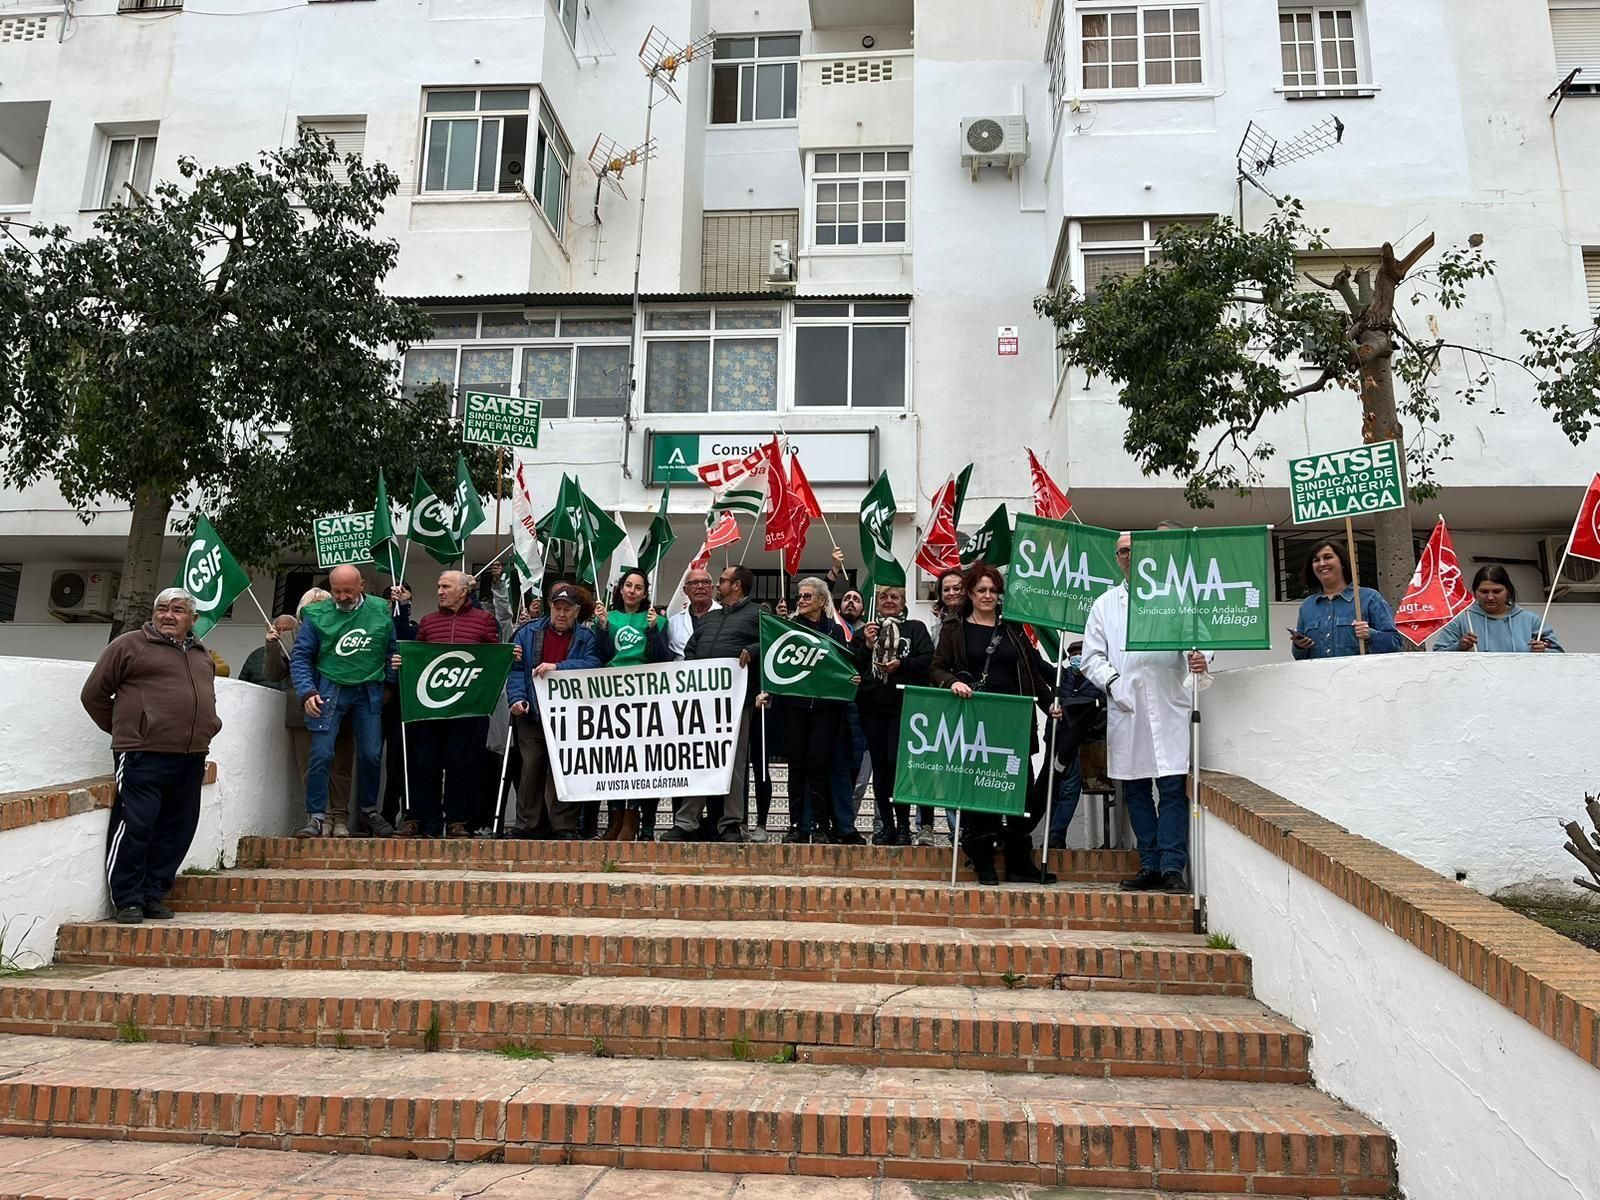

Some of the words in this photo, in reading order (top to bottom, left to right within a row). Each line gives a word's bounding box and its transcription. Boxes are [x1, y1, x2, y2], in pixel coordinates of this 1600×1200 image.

[469, 394, 539, 418] SATSE
[468, 411, 520, 425] SINDICATO
[523, 418, 537, 427] DE
[468, 419, 536, 434] ENFERMERIA
[466, 427, 534, 447] MALAGA
[1294, 444, 1393, 481] SATSE
[1295, 472, 1370, 493] SINDICATO
[1374, 467, 1394, 480] DE
[1296, 478, 1395, 503] ENFERMERIA
[1297, 489, 1397, 520] MALAGA
[319, 532, 365, 545] SINDICATO
[320, 539, 371, 552] ENFERMER
[321, 547, 373, 565] MALAG
[1016, 539, 1091, 591] SMA
[188, 544, 222, 593] CSIF
[1136, 553, 1226, 606] SMA
[1014, 582, 1049, 596] Sindicato
[1138, 605, 1176, 615] Sindicato
[1178, 604, 1210, 614] Médico
[1211, 605, 1249, 614] Andaluz
[1211, 613, 1258, 627] Málaga
[776, 643, 829, 667] CSIF
[429, 667, 483, 689] CSIF
[547, 677, 583, 701] POR
[587, 671, 671, 699] NUESTRA
[675, 667, 732, 694] SALUD
[577, 701, 664, 742] BASTA
[672, 699, 706, 735] YA
[714, 697, 733, 734] !!
[907, 711, 989, 764] SMA
[559, 745, 638, 776] UANMA
[907, 760, 943, 772] Sindicato
[945, 763, 975, 775] Médico
[975, 767, 1008, 779] Andaluz
[595, 780, 607, 792] AV
[608, 779, 629, 791] VISTA
[631, 778, 651, 790] VEGA
[652, 775, 689, 788] CÁRTAMA
[974, 775, 1016, 792] Málaga
